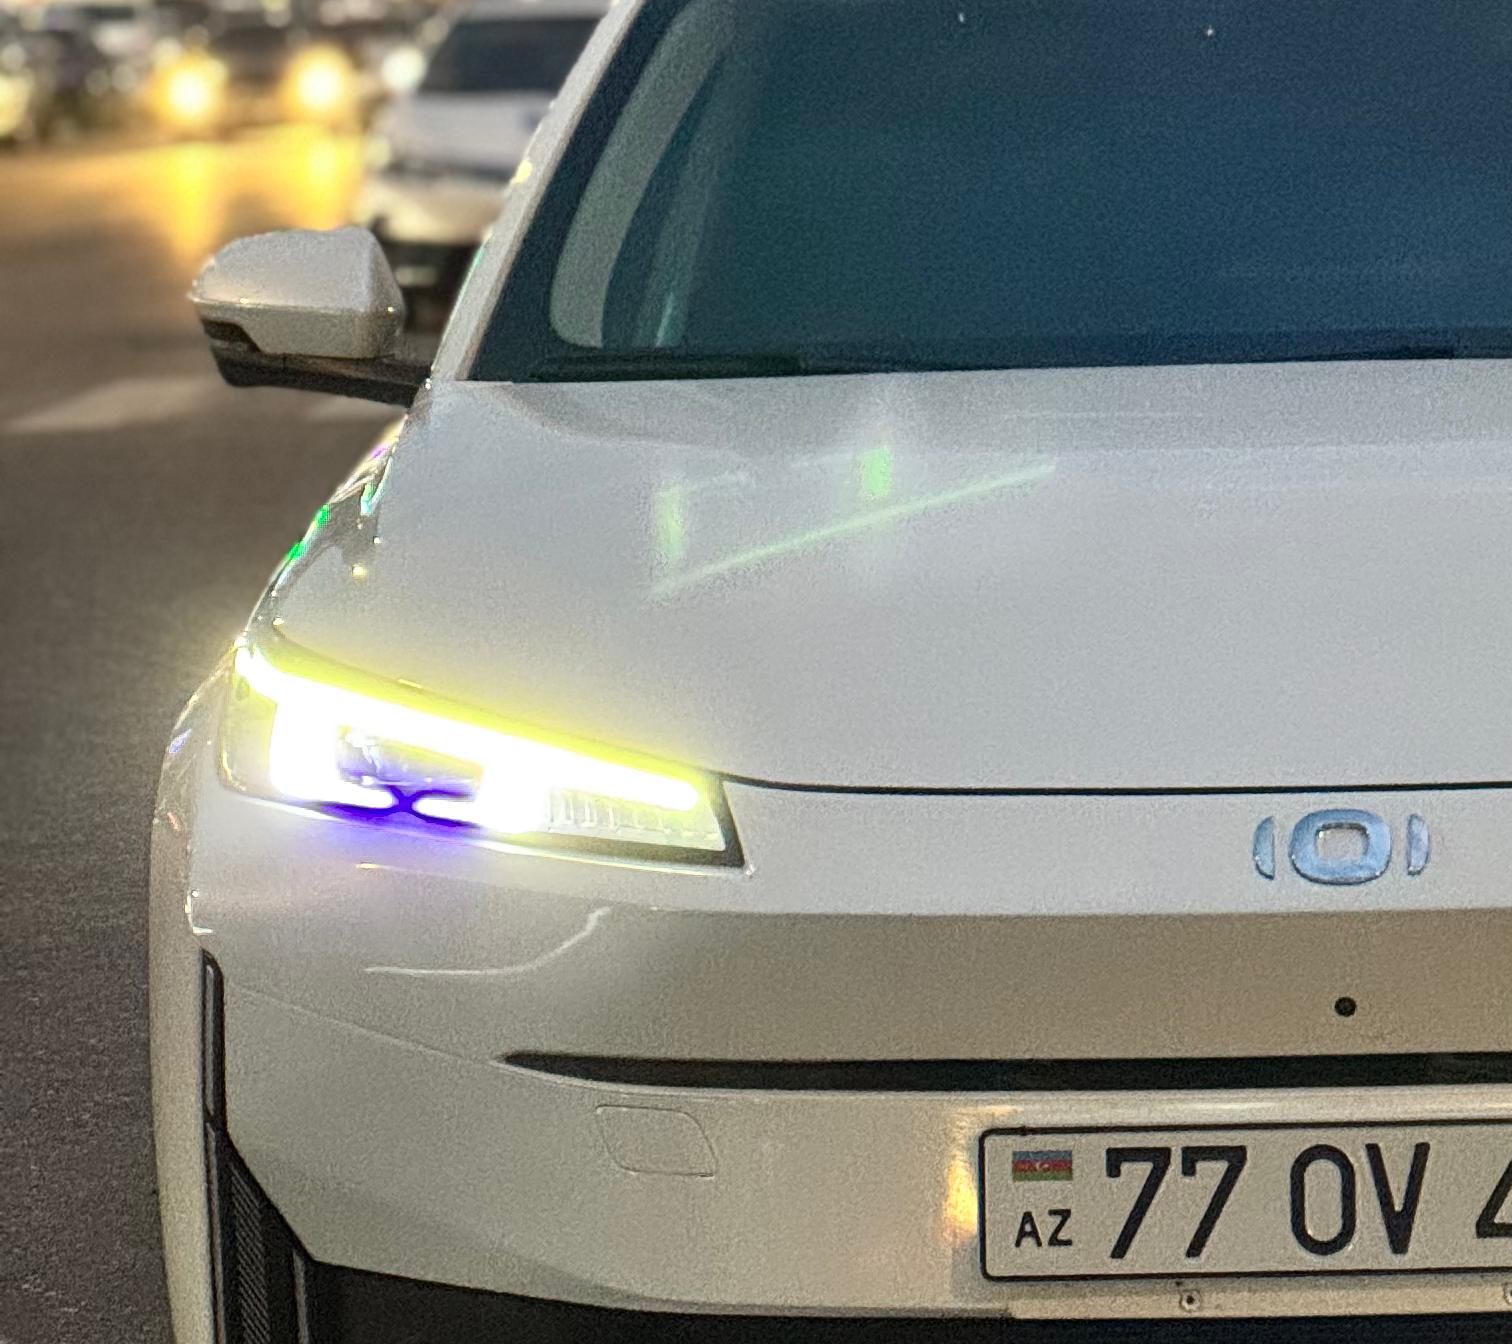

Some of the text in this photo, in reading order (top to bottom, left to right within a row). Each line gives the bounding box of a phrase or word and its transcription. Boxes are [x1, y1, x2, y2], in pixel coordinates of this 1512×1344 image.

[1015, 1208, 1072, 1248] AZ
[1106, 1146, 1248, 1259] 77
[1290, 1142, 1431, 1255] OV
